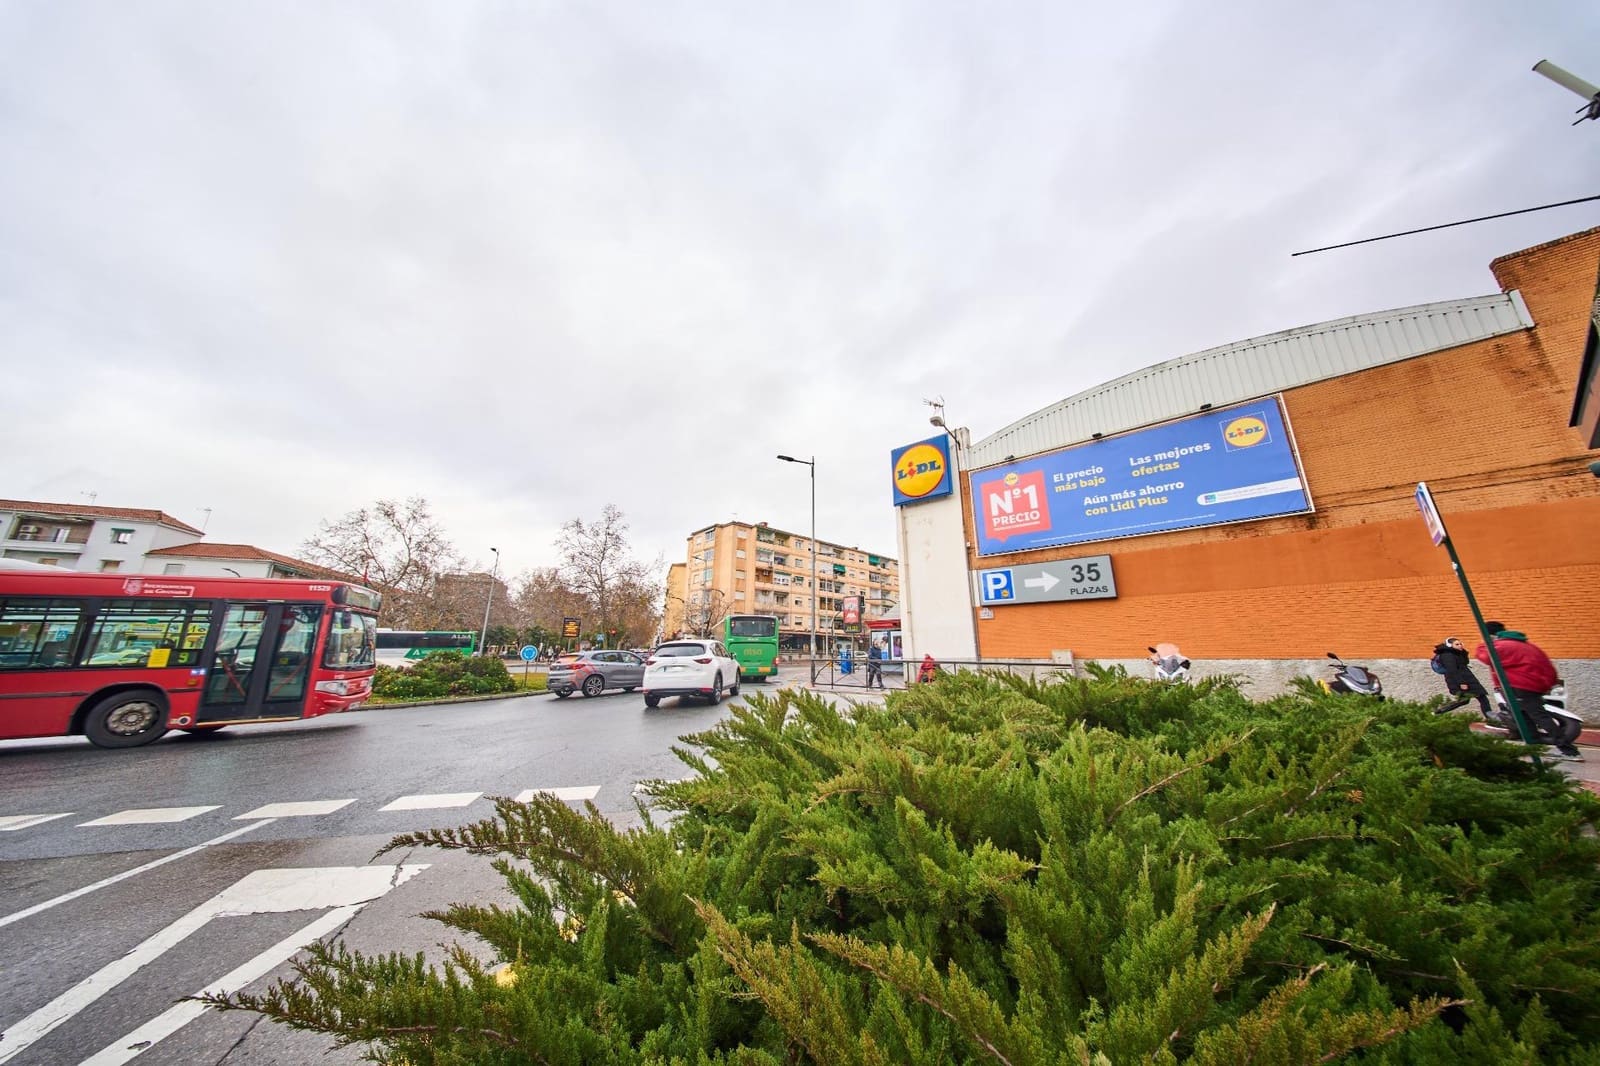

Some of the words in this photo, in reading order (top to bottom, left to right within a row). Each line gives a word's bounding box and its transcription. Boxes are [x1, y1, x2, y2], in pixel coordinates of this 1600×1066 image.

[1129, 455, 1152, 467] Las
[1155, 442, 1211, 460] mejores
[1053, 473, 1065, 483] El
[1066, 465, 1104, 482] precio
[1131, 460, 1181, 478] ofertas
[1055, 481, 1078, 493] más
[1080, 476, 1106, 488] bajo
[1083, 494, 1108, 506] Aún
[1110, 489, 1137, 502] más
[1140, 482, 1184, 495] ahorro
[1085, 506, 1108, 517] con
[1110, 500, 1136, 513] Lidl
[1138, 495, 1169, 508] Plus
[993, 511, 1040, 527] PRECIO
[987, 573, 1007, 600] P
[1070, 562, 1101, 584] 35
[1070, 585, 1109, 596] PLAZAS
